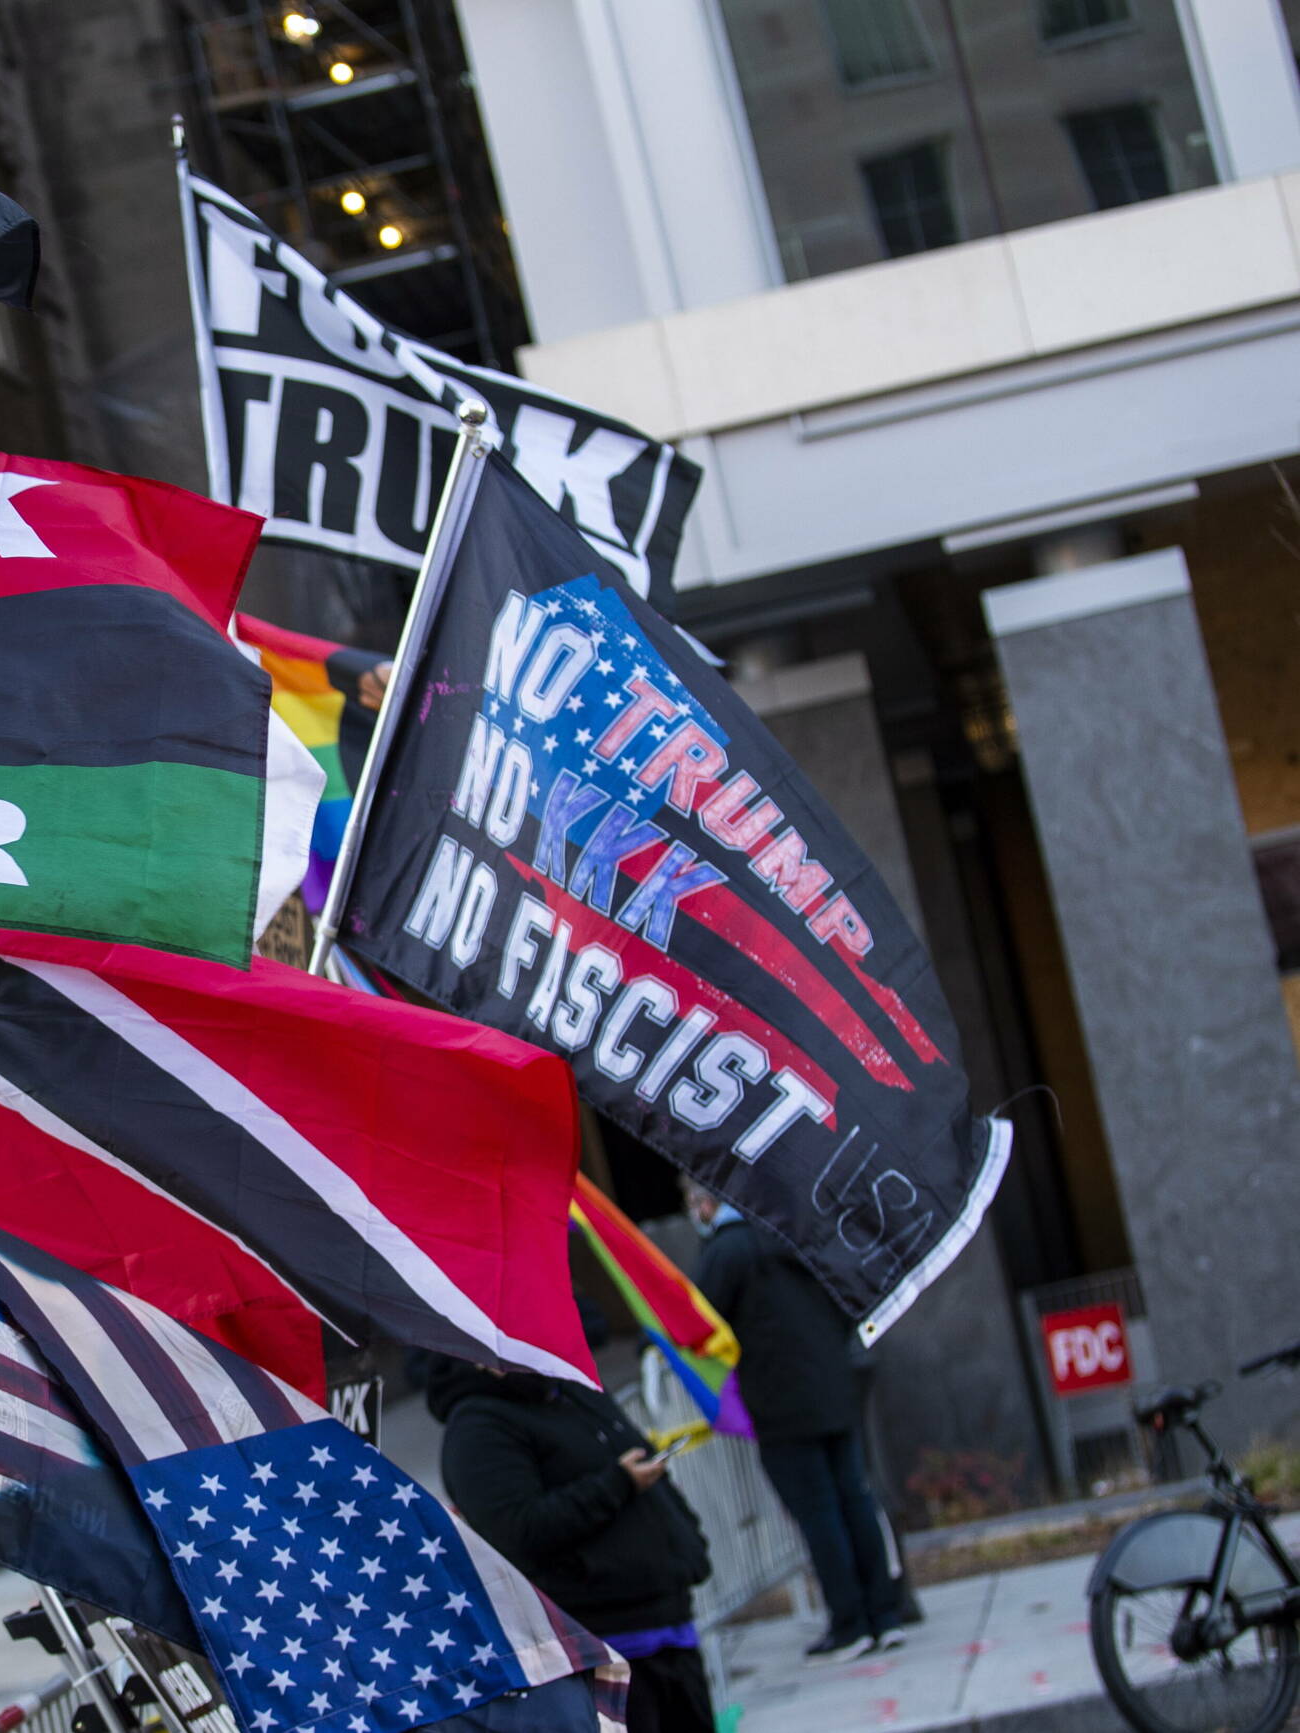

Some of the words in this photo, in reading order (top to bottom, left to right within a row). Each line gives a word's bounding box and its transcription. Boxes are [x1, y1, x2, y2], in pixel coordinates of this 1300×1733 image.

[452, 712, 533, 847] NO
[533, 766, 729, 951] KKK
[483, 589, 598, 723] NO
[591, 677, 874, 956] TRUMP
[404, 834, 498, 969] NO
[498, 891, 834, 1166] FASCIST
[812, 1125, 933, 1290] USA
[1050, 1320, 1125, 1381] FDC
